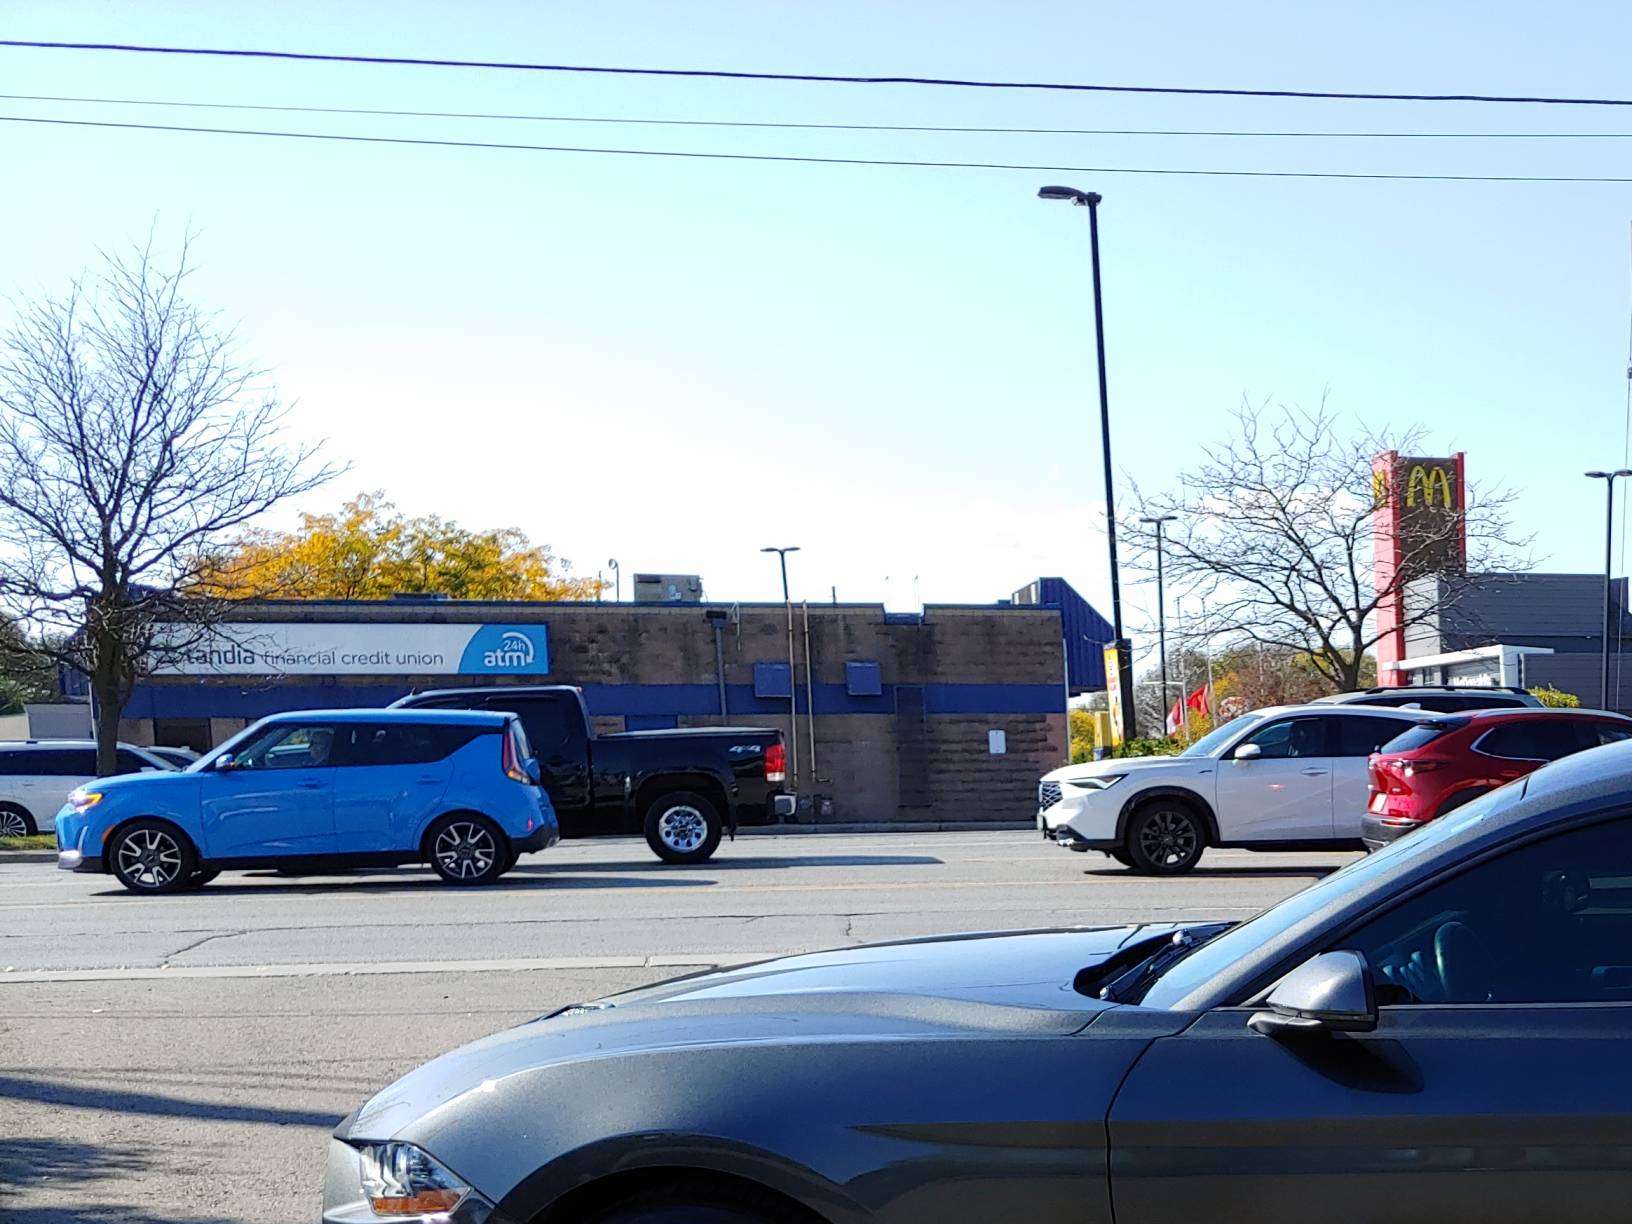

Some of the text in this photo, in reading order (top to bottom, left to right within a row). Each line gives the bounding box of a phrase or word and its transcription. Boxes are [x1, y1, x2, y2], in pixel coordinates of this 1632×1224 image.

[504, 639, 525, 650] 24h
[264, 650, 335, 665] financial
[341, 651, 391, 665] credit
[396, 651, 444, 665] union
[484, 648, 525, 667] atm
